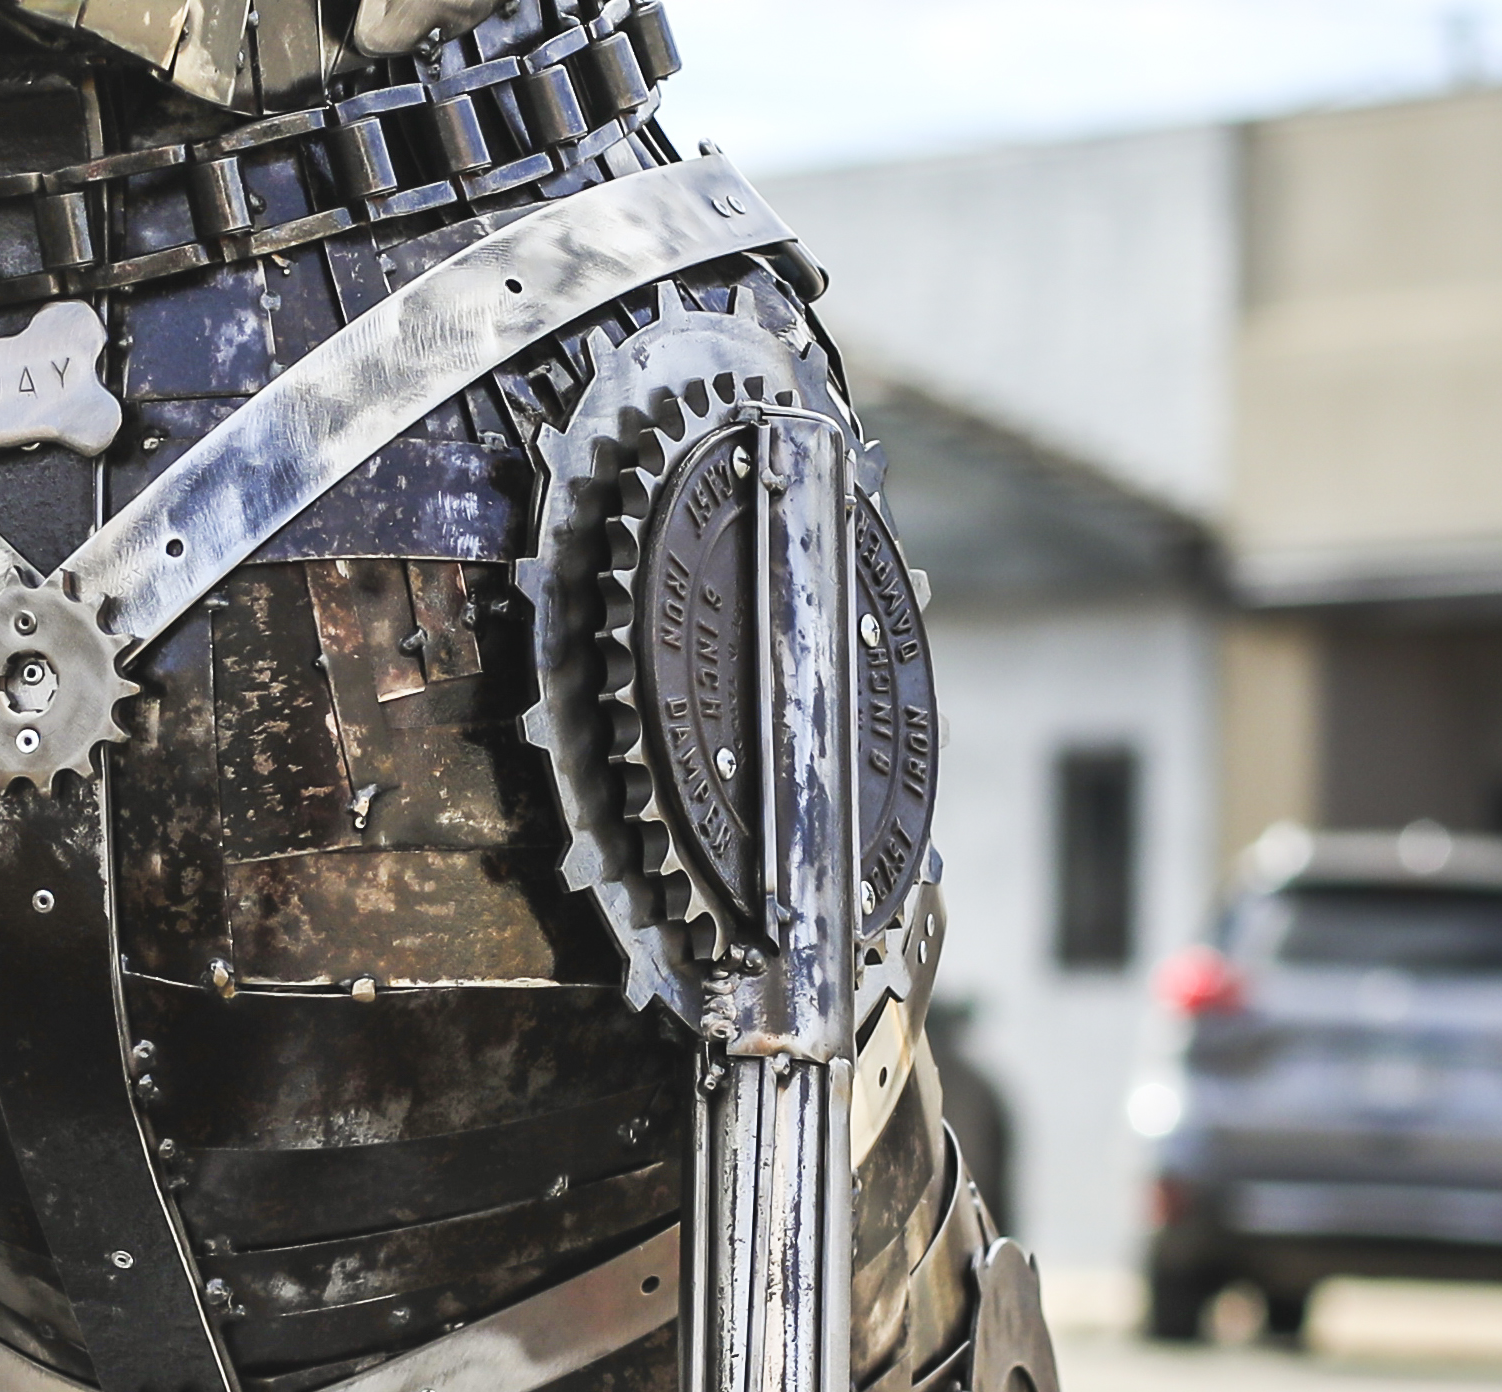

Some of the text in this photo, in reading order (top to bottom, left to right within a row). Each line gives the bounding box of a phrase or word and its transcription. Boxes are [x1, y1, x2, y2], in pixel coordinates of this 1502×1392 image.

[661, 459, 734, 857] CAST IRON DAMPER
[698, 618, 723, 718] INCH
[856, 510, 928, 902] CAST IRON DAMPER
[867, 648, 892, 740] INCH
